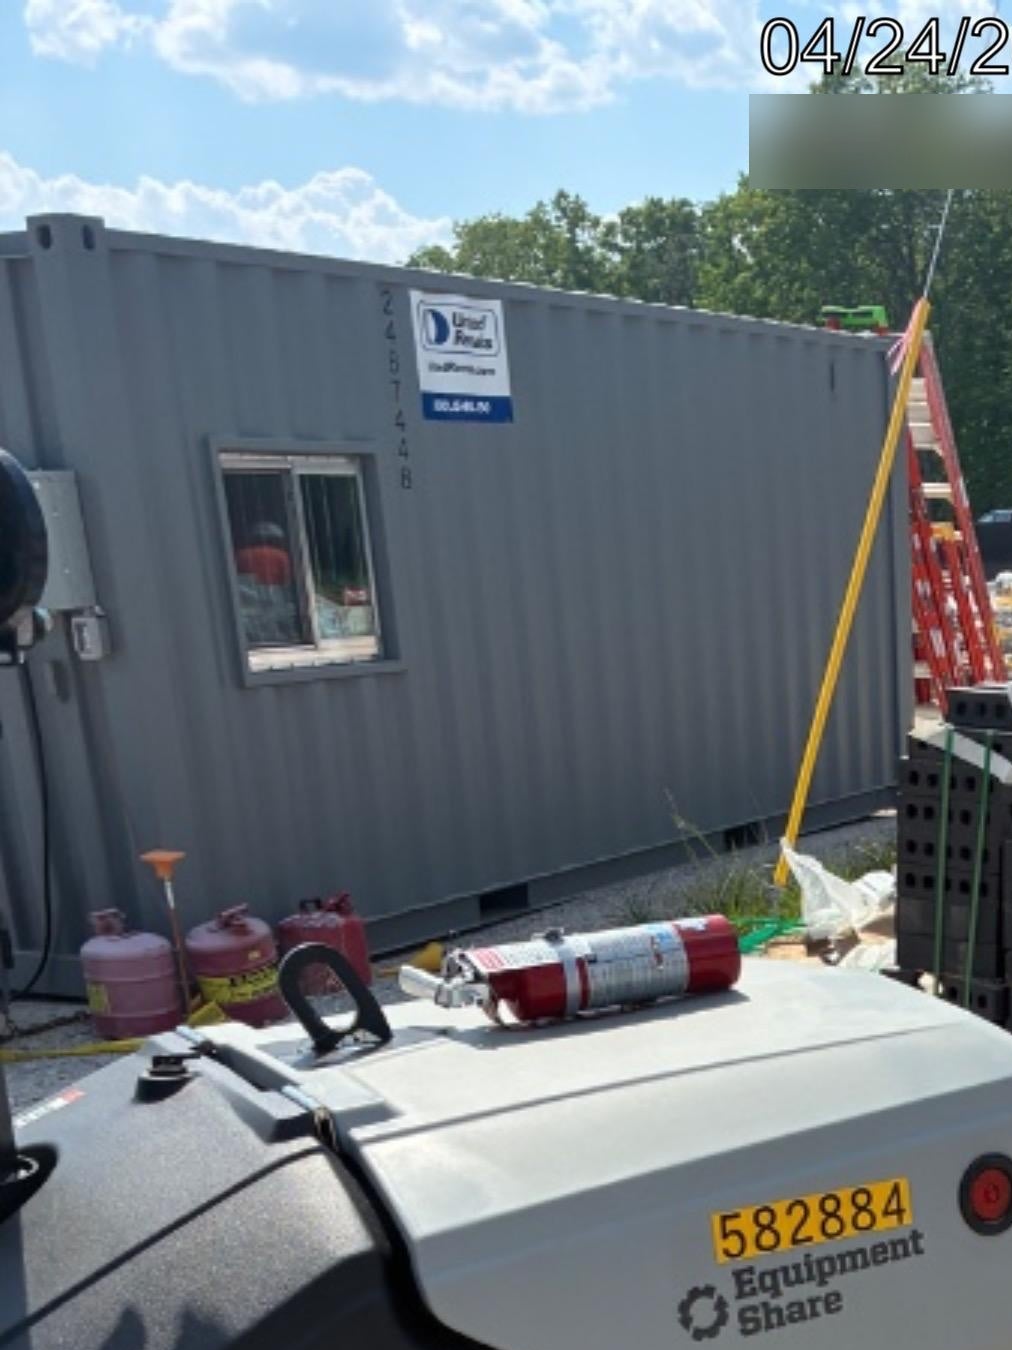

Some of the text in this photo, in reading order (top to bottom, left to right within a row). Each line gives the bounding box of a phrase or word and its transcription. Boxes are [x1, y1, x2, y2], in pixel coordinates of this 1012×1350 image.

[718, 1181, 908, 1259] 582884
[732, 1229, 925, 1301] Equipment
[737, 1289, 844, 1337] Share
